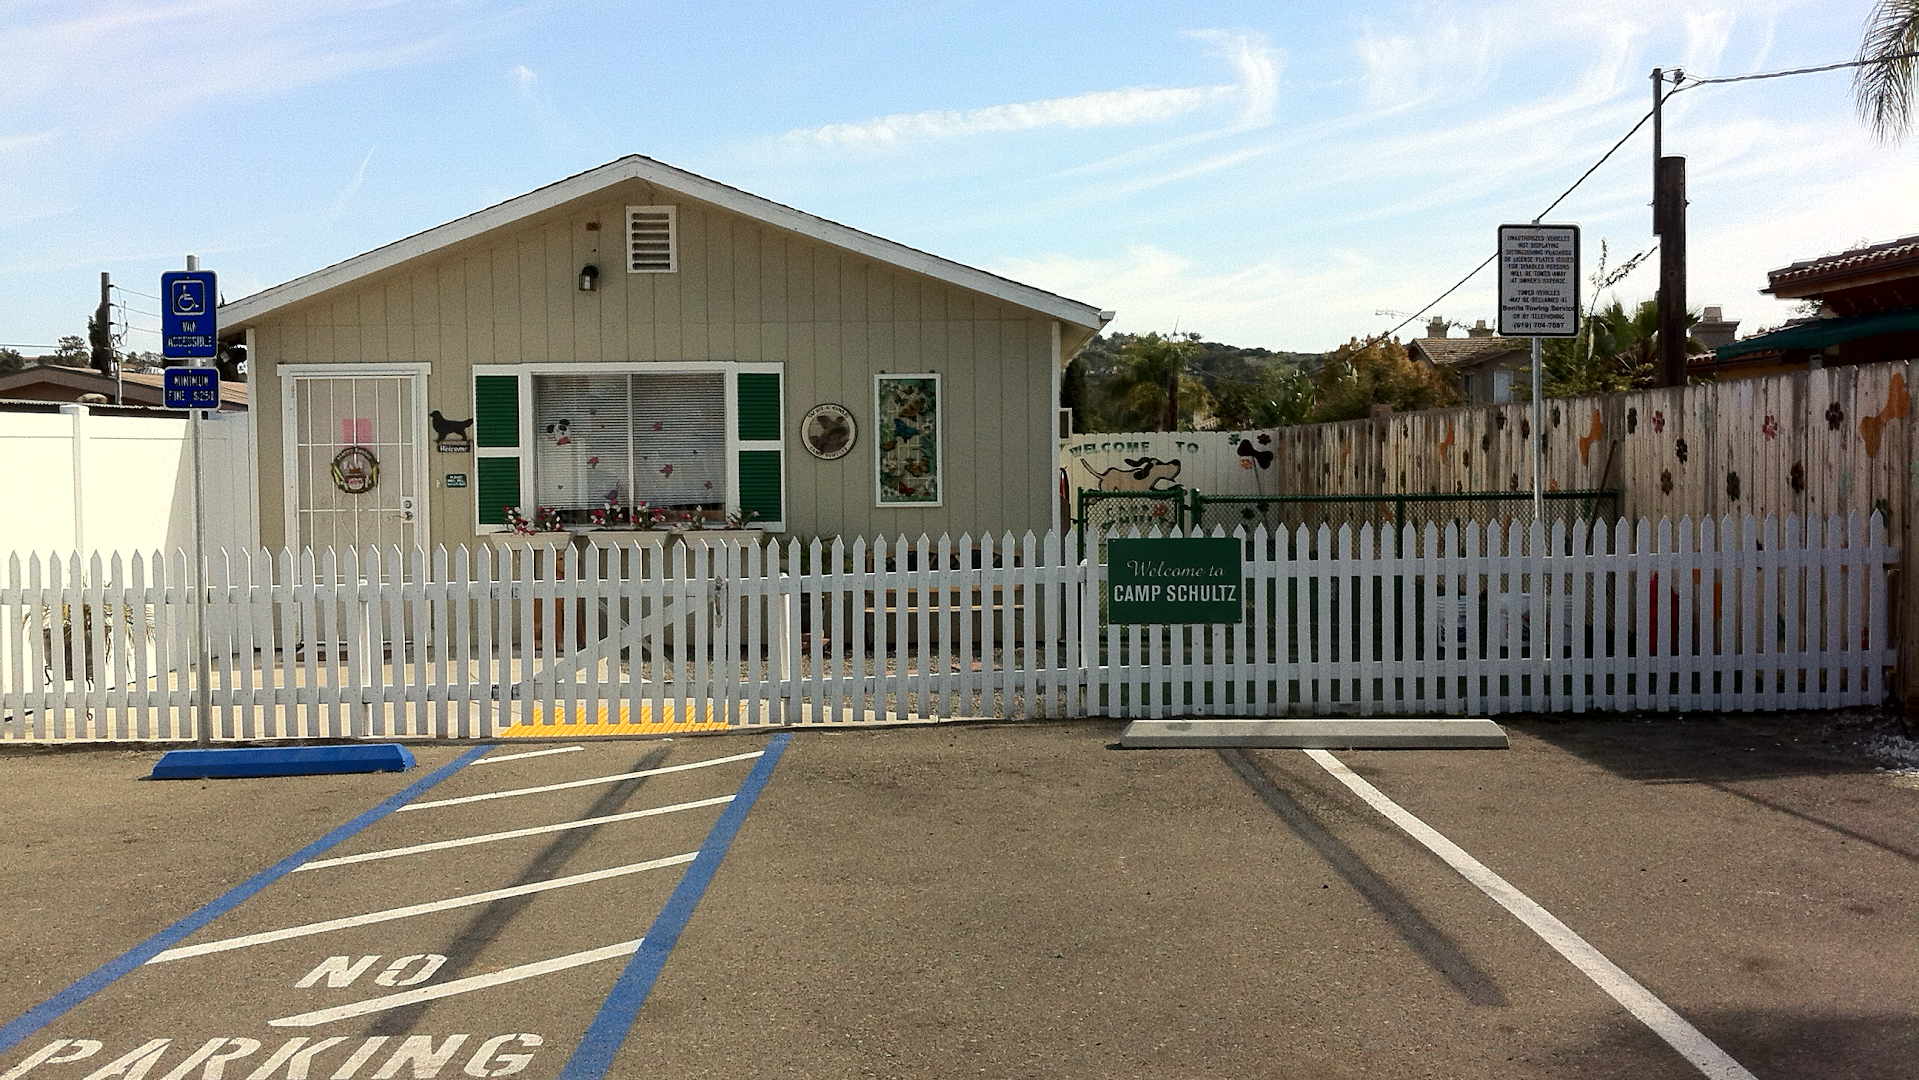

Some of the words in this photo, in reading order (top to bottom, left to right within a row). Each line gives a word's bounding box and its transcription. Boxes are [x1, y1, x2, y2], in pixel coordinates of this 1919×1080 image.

[182, 321, 196, 333] VAN
[167, 336, 212, 347] ACCESSIBLE
[173, 375, 209, 387] MINIMUM
[168, 390, 185, 401] FINE
[1069, 441, 1150, 458] WELCOME
[1175, 441, 1198, 454] TO
[1126, 560, 1206, 577] Welcome
[1209, 565, 1225, 577] to
[1114, 584, 1161, 602] CAMP
[1166, 584, 1236, 602] SCHULTZ
[294, 954, 448, 988] NO
[0, 1033, 544, 1080] PARKING
